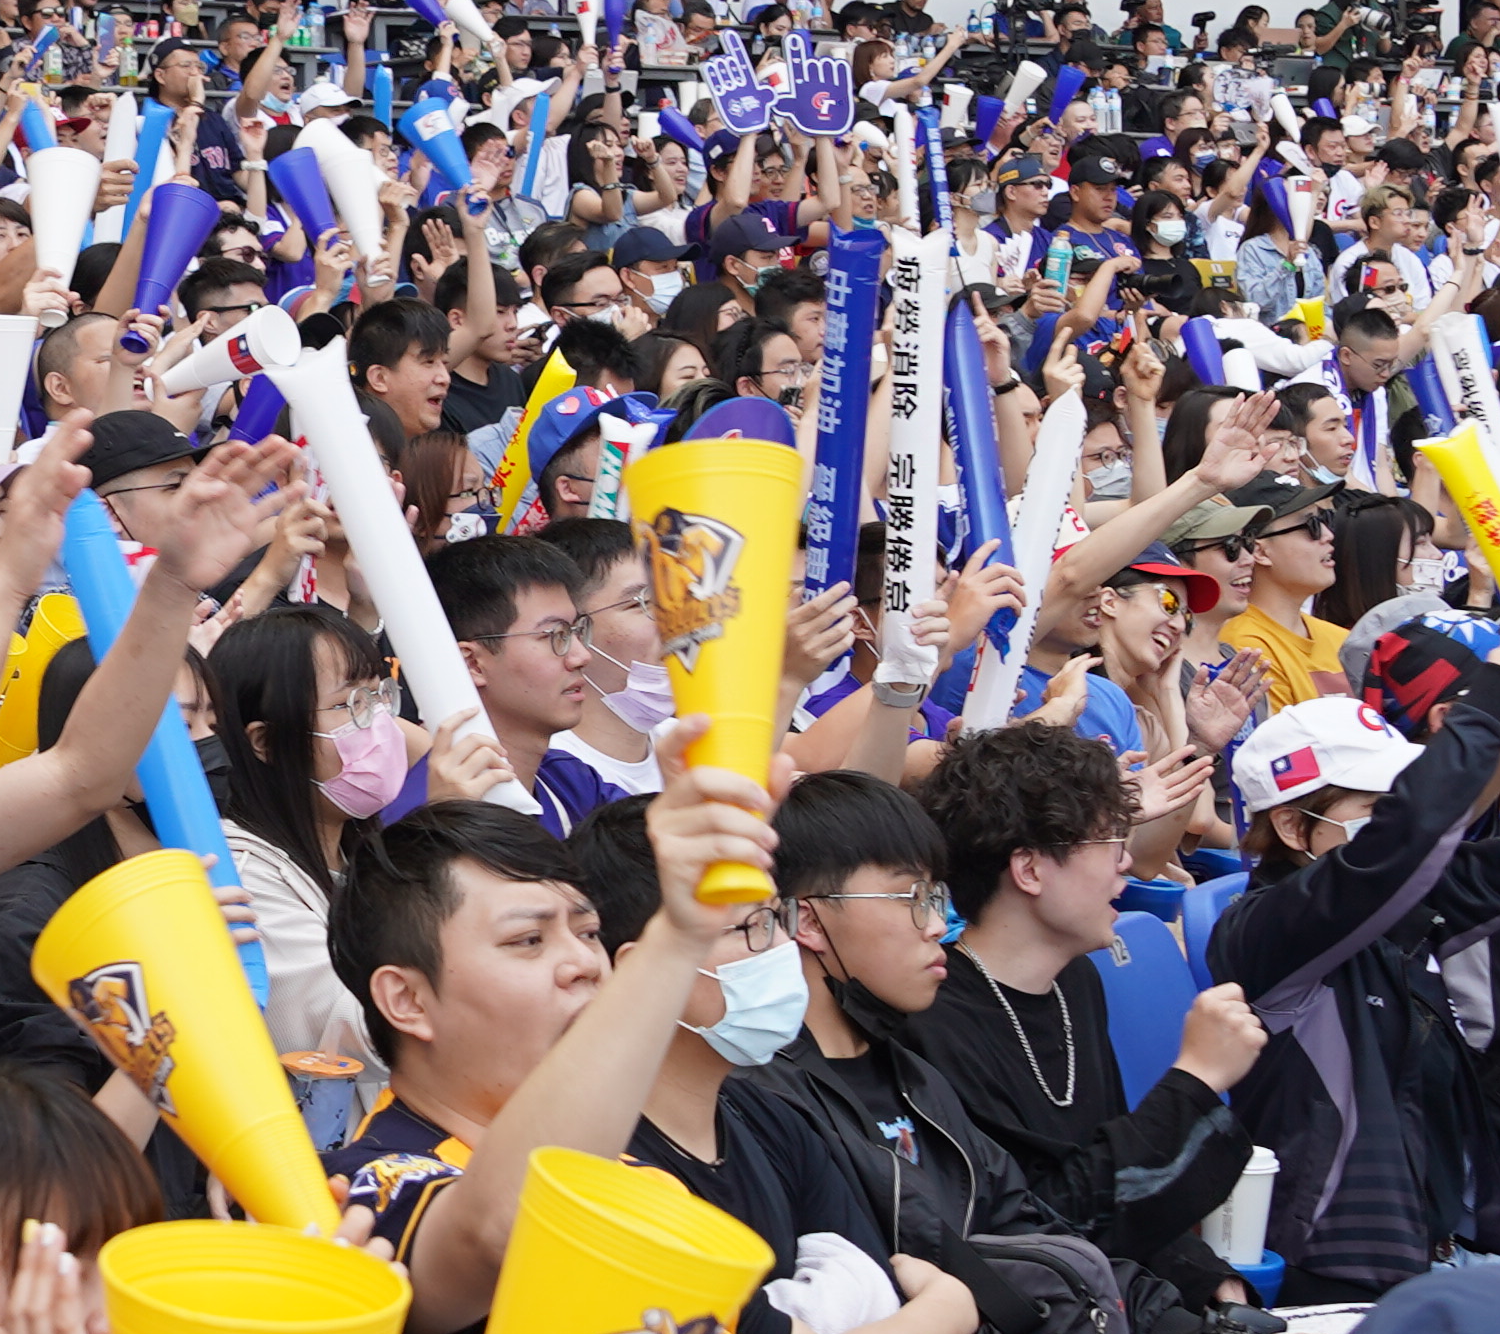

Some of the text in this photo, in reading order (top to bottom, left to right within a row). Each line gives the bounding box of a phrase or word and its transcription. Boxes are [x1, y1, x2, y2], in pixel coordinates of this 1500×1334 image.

[885, 254, 923, 615] 疲勞消除 完勝倦怠
